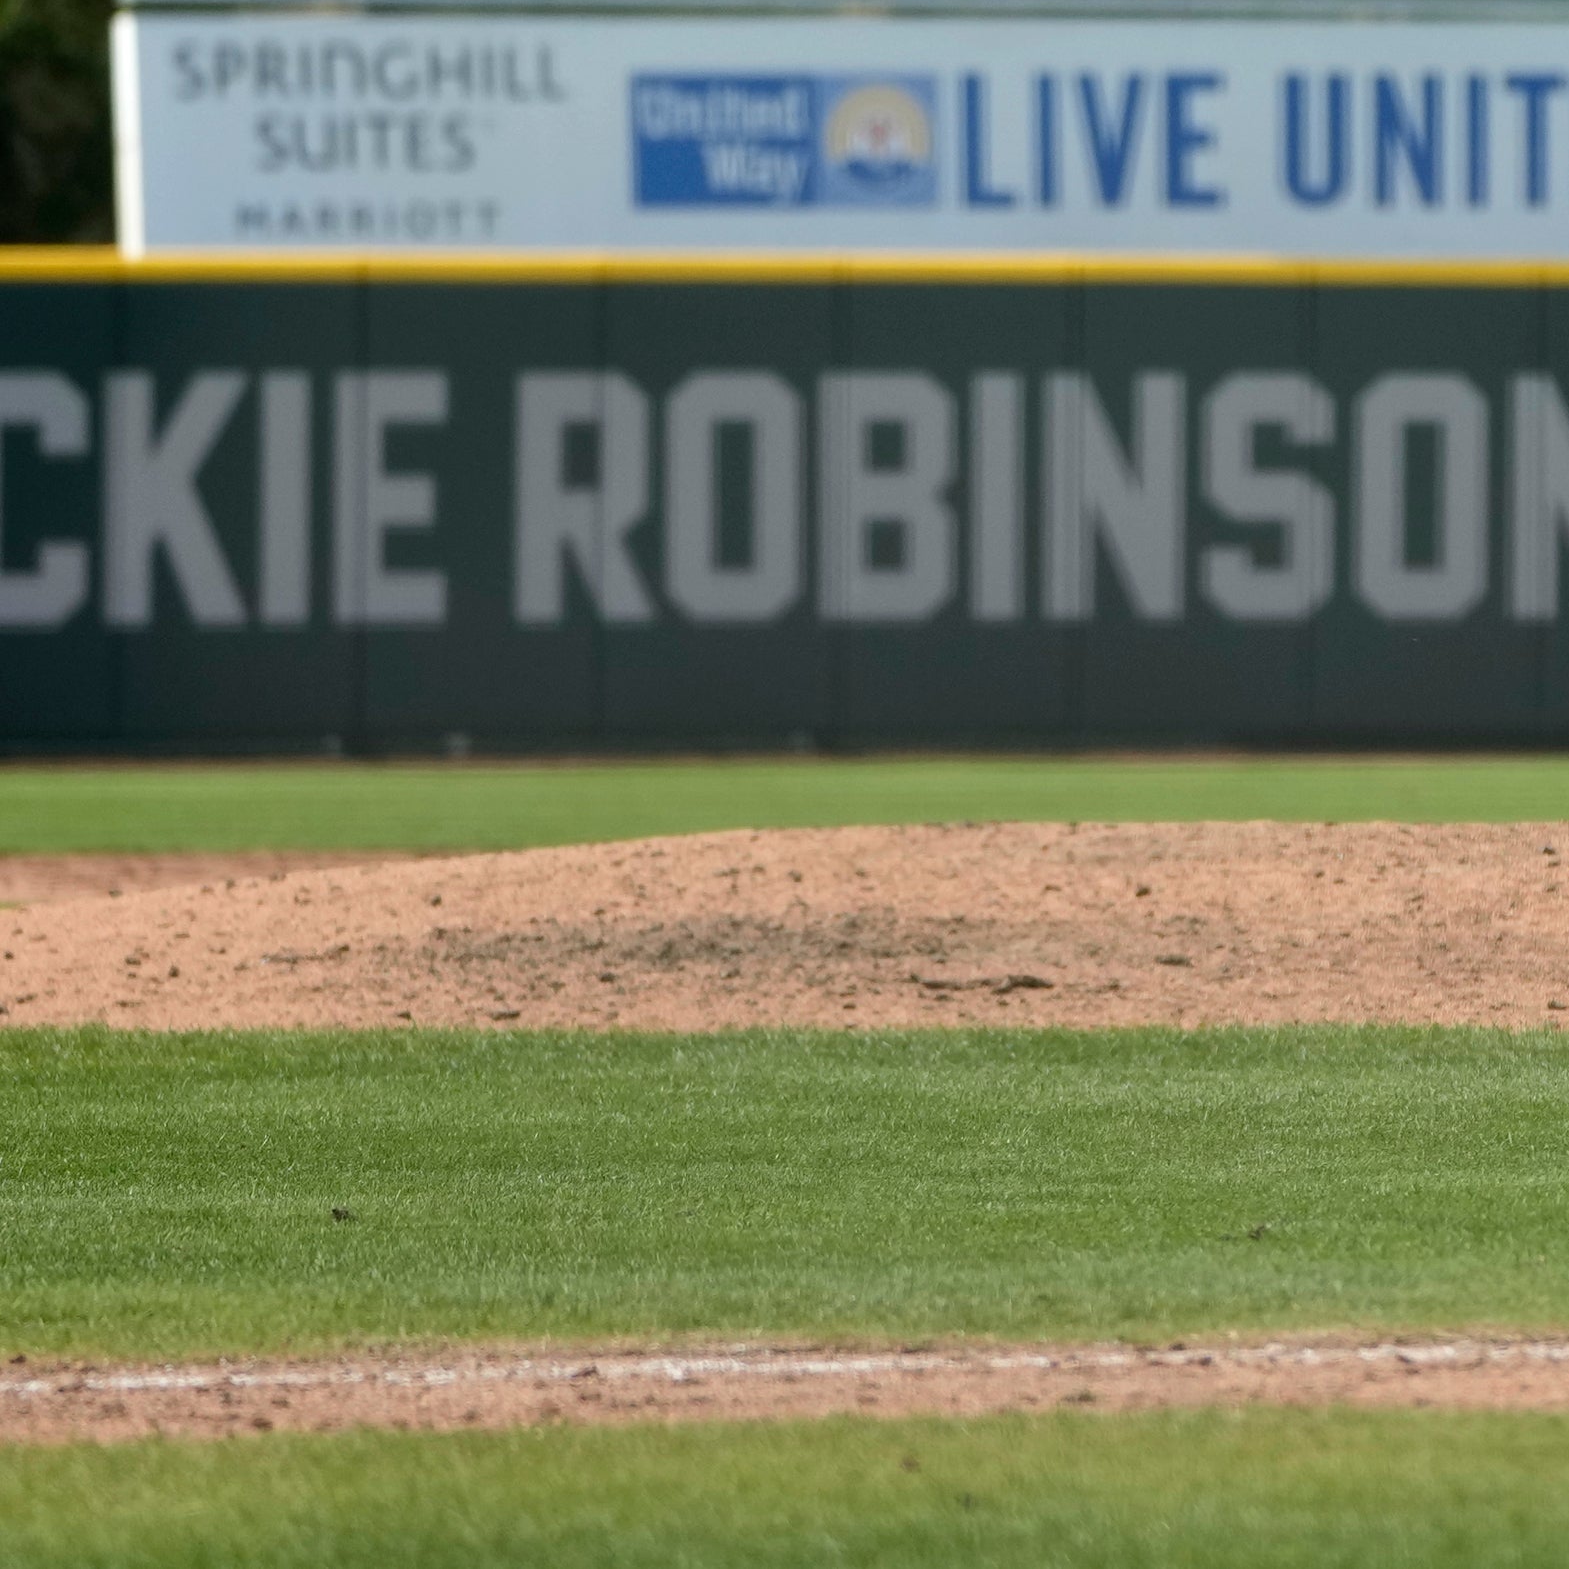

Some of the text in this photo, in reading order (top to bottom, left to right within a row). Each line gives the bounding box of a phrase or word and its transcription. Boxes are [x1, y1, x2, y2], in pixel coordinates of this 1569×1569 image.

[173, 39, 569, 103] SPRINGHILL
[256, 112, 477, 174] SUITES
[959, 72, 1229, 208] LIVE
[702, 144, 813, 201] Way
[235, 199, 503, 240] MARRIOTT
